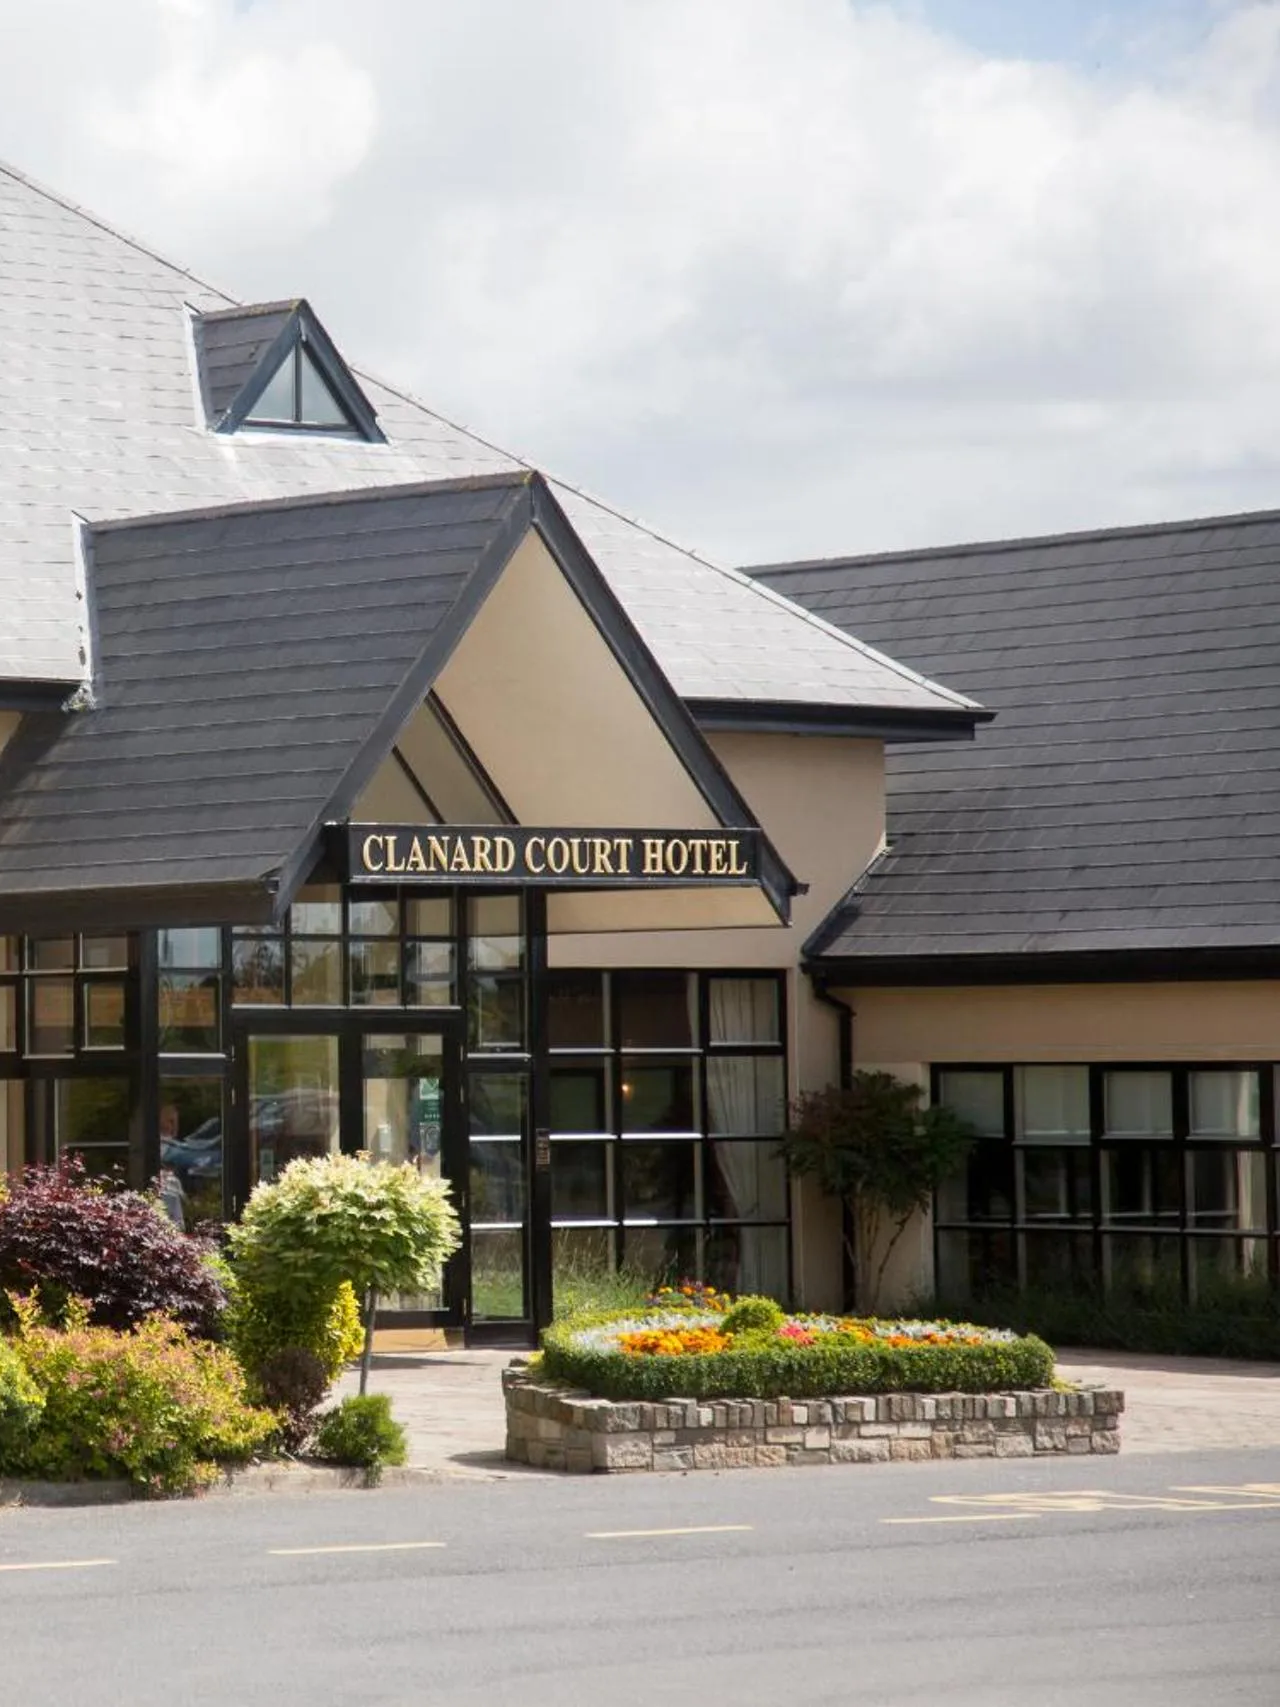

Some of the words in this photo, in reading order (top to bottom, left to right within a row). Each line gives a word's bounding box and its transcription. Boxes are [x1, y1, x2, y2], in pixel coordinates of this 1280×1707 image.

[363, 835, 515, 873] CLANARD
[525, 837, 632, 873] COURT
[643, 839, 747, 874] HOTEL
